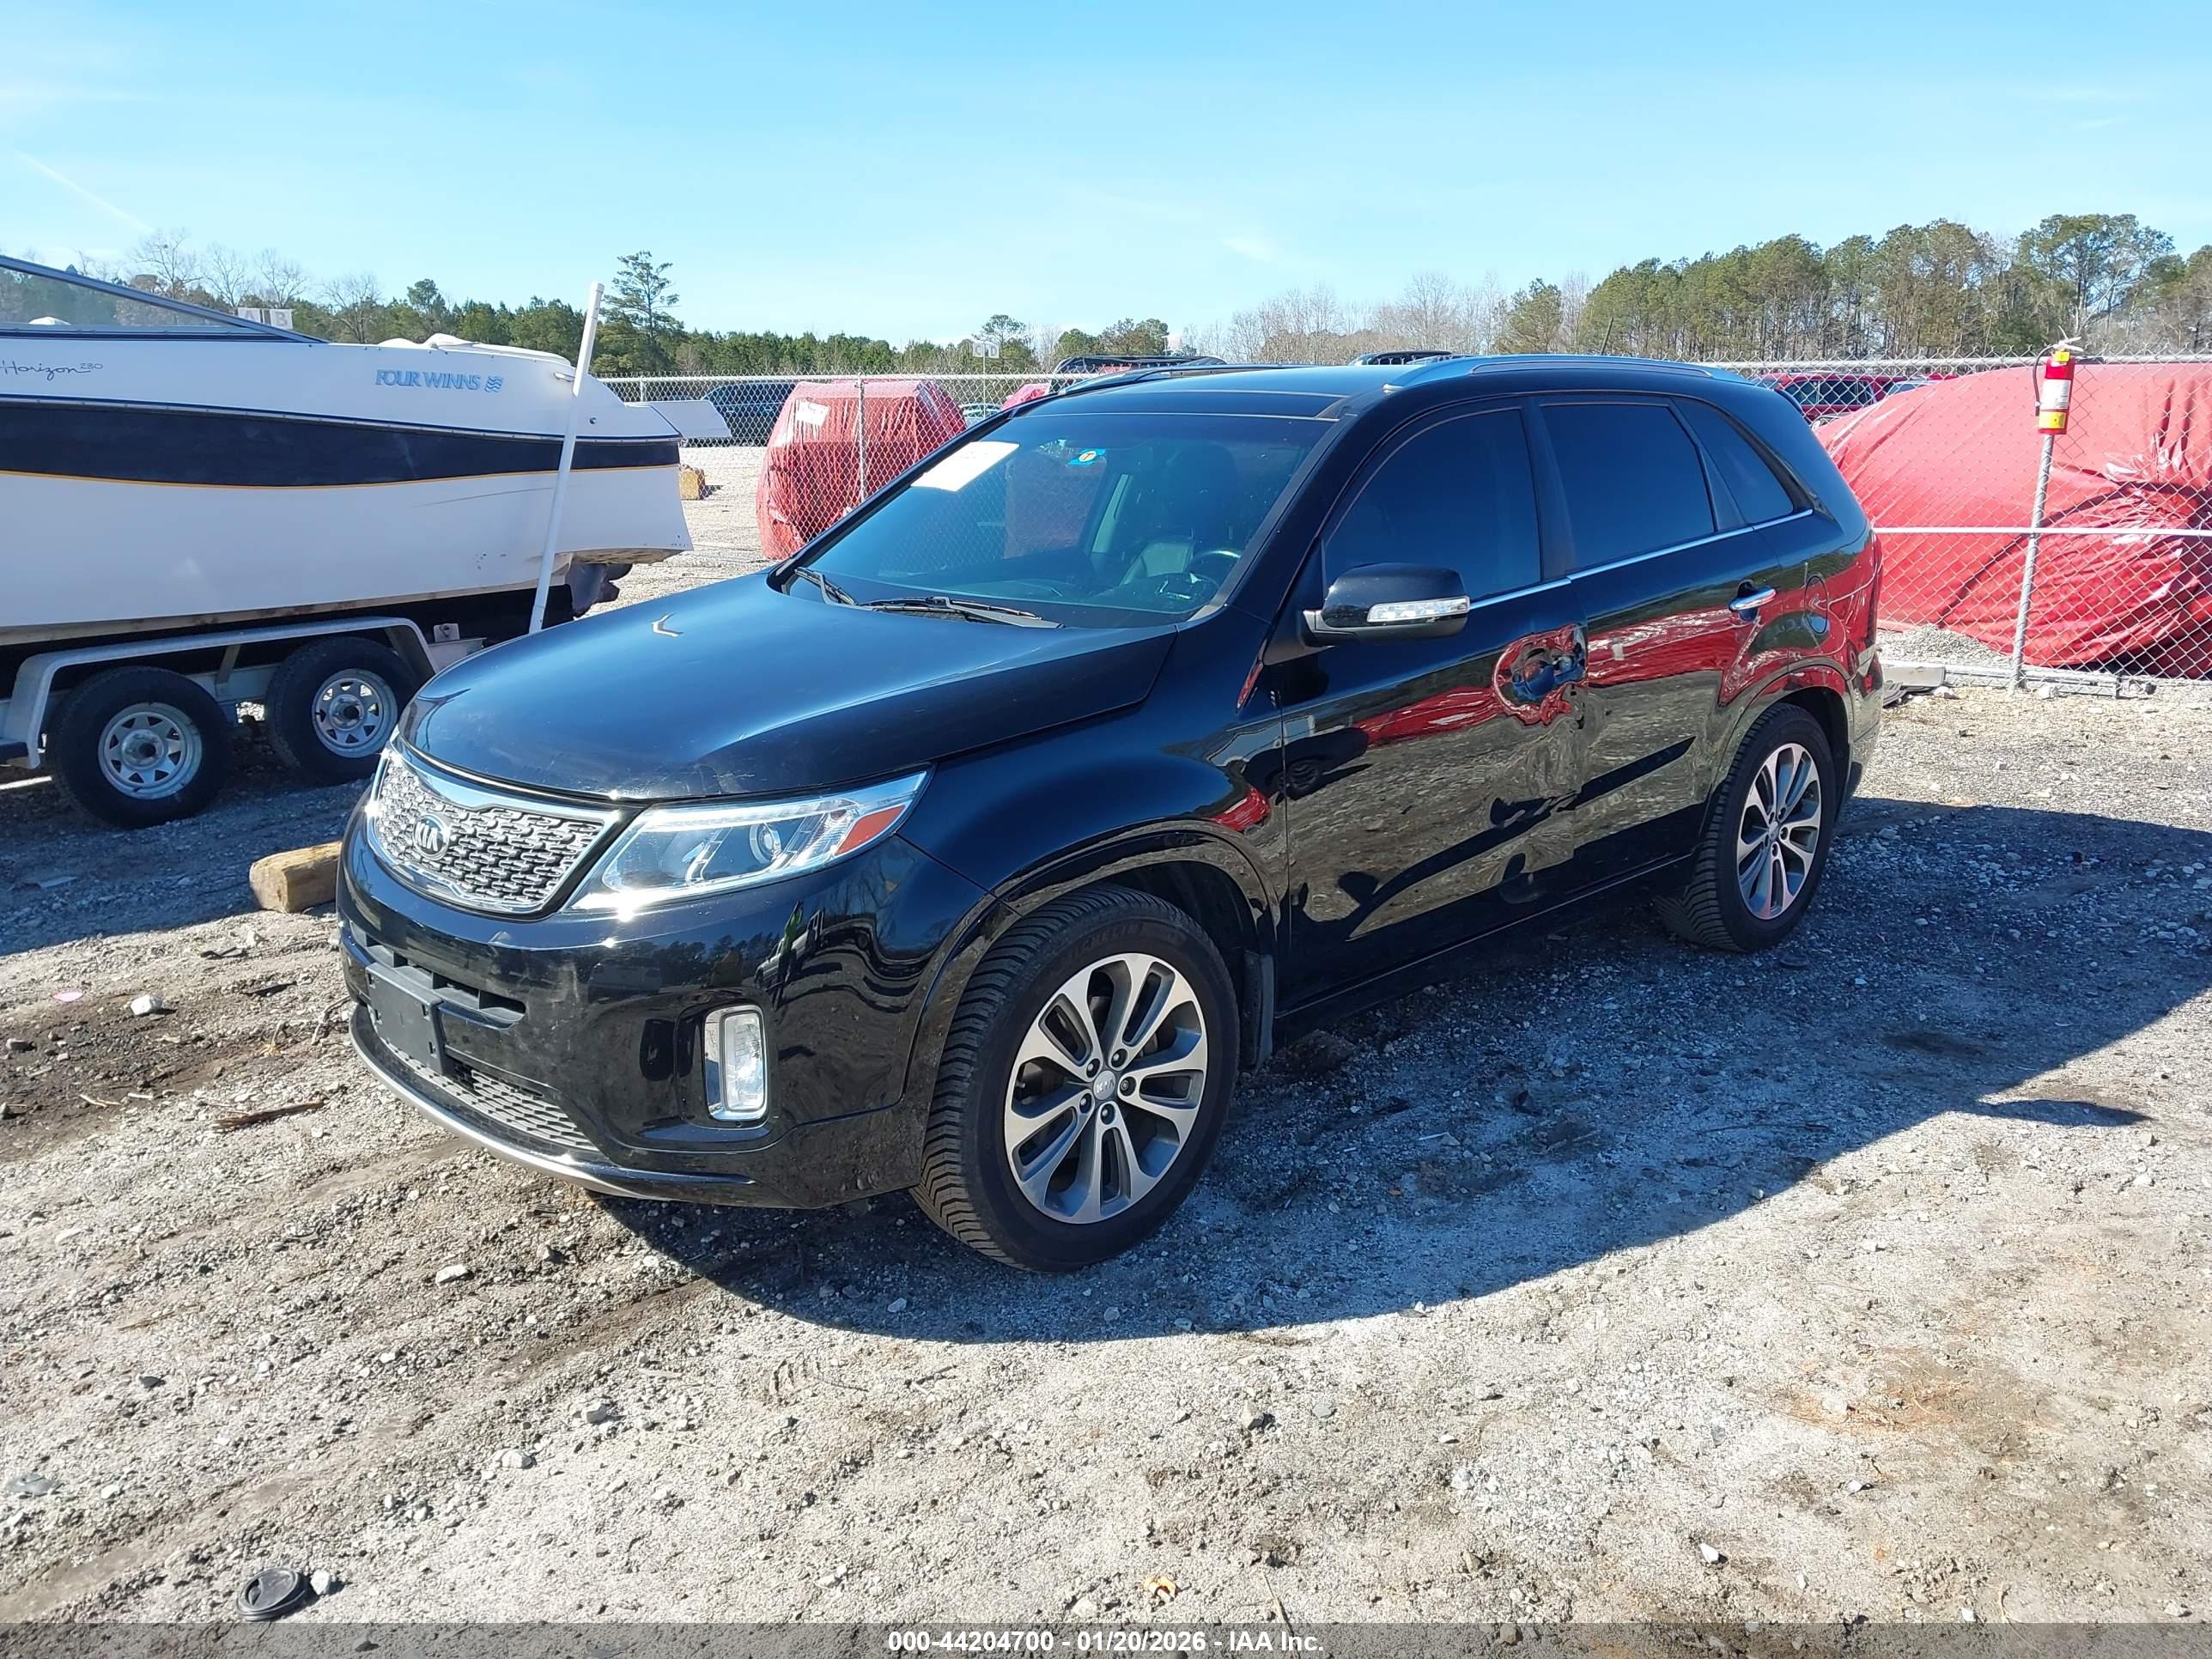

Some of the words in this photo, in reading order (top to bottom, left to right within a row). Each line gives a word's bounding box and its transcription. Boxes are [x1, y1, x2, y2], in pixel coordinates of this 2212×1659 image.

[374, 369, 421, 386] FOUR
[423, 371, 481, 390] WINNS
[414, 821, 439, 852] KIA
